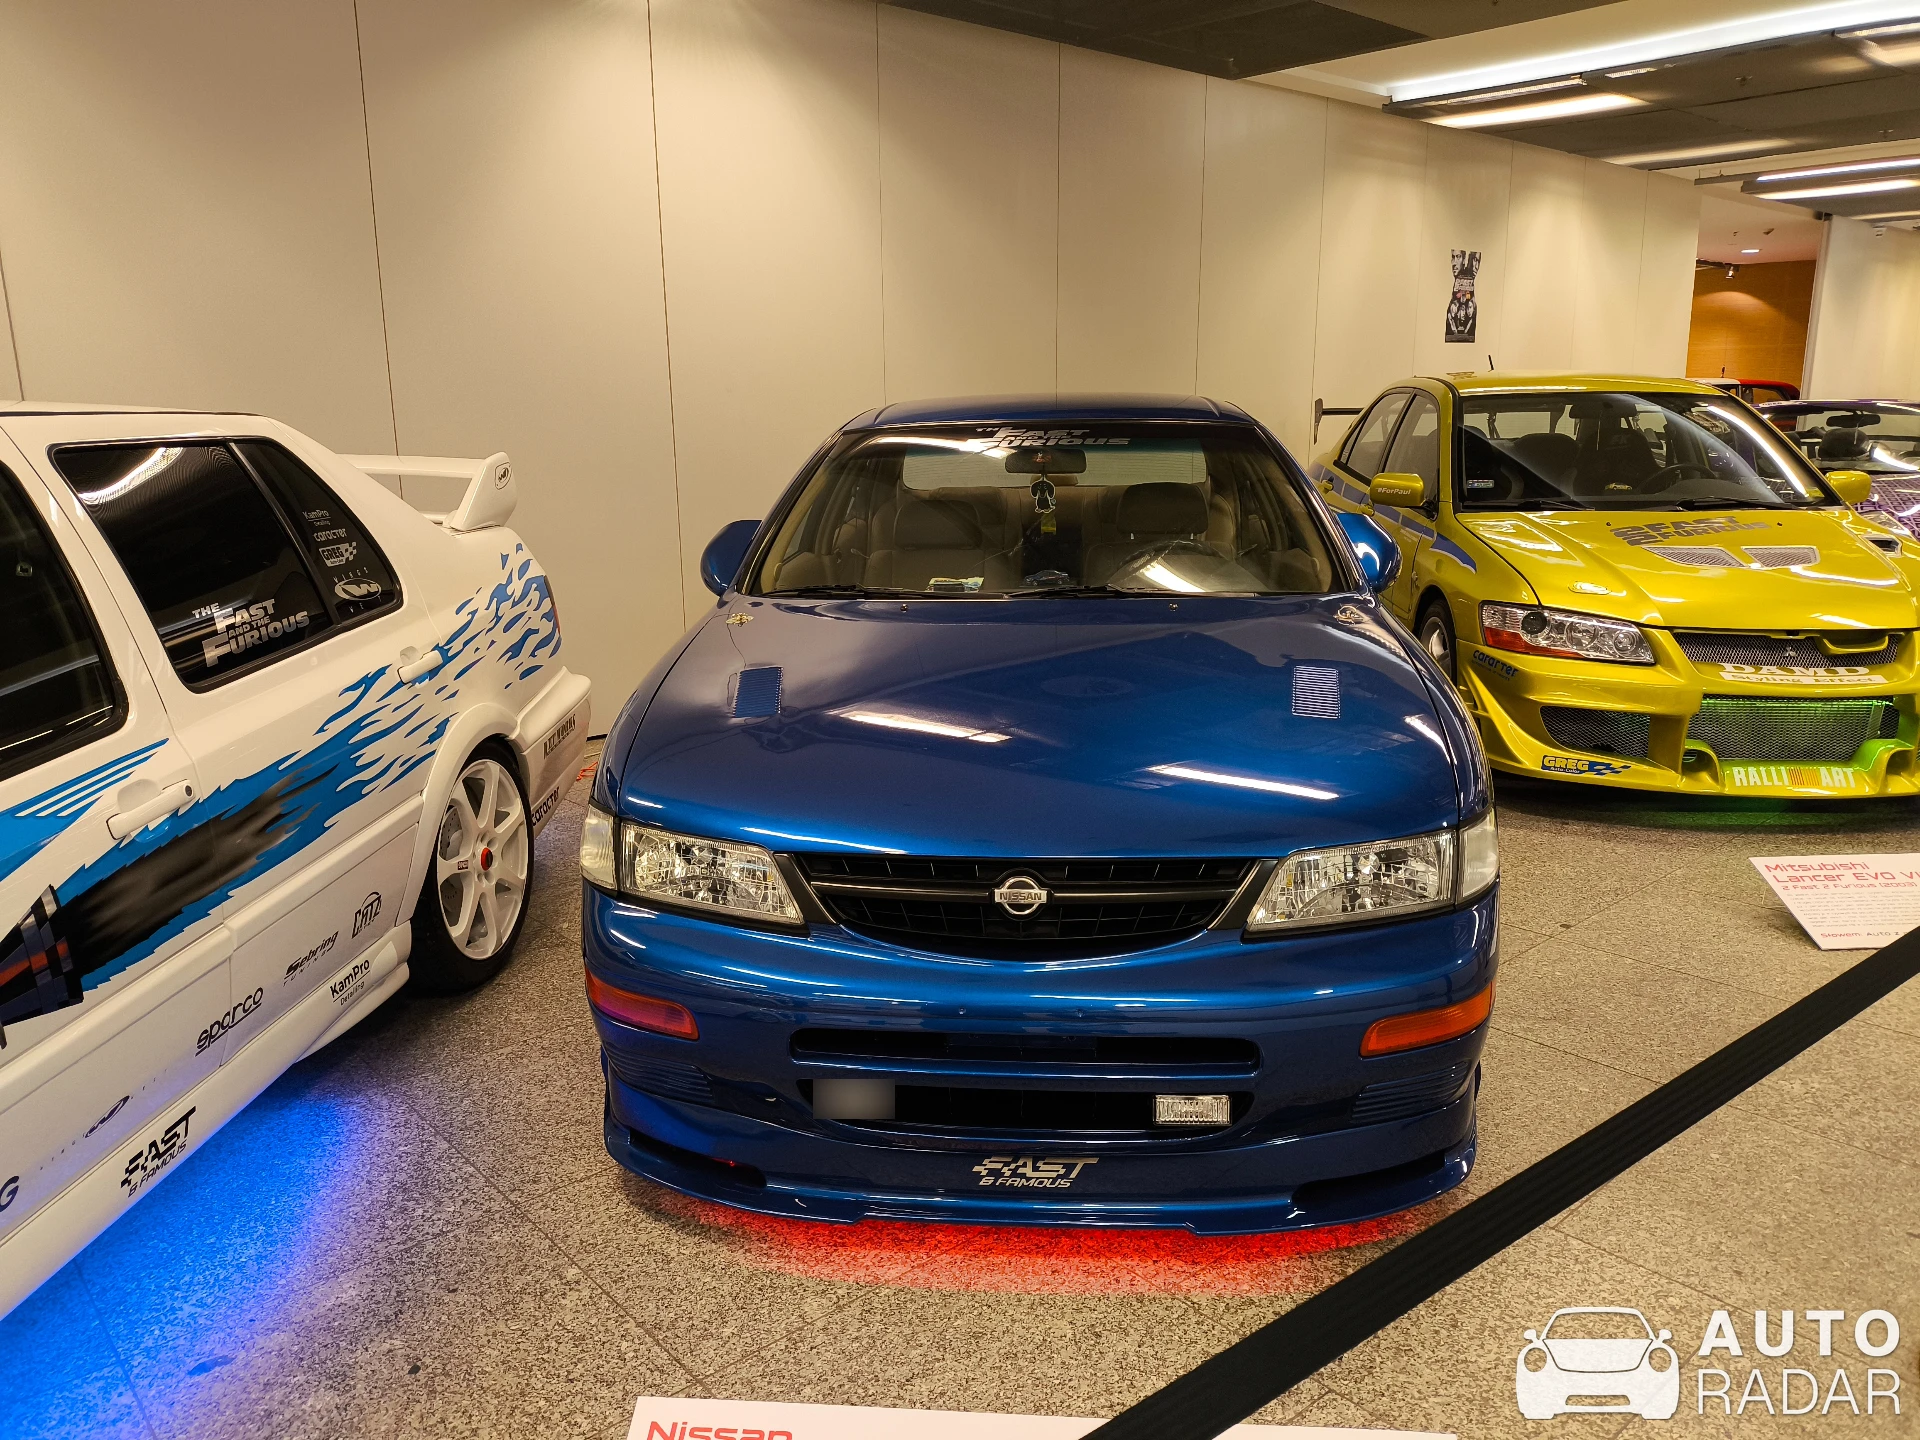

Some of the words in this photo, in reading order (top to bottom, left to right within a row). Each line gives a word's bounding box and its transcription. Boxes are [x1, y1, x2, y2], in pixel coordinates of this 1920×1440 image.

[993, 426, 1090, 438] FAST
[302, 509, 330, 519] KamPro
[321, 546, 346, 560] GREG
[192, 602, 221, 619] THE
[213, 599, 275, 633] FAST
[228, 623, 251, 638] AND
[251, 615, 271, 629] THE
[202, 611, 310, 667] FURIOUS
[1719, 662, 1870, 676] DAMD
[1731, 674, 1804, 684] Styling
[1543, 756, 1590, 771] GREG
[1764, 861, 1870, 873] Mitsubishi
[1772, 873, 1846, 883] Lancer
[1852, 871, 1896, 881] EVO
[1000, 892, 1042, 901] NISSAN
[284, 931, 339, 980] Sebring
[330, 959, 370, 999] KamPro
[195, 987, 264, 1054] sparco
[120, 1105, 197, 1188] FAST
[139, 1149, 188, 1188] FAMOUS
[971, 1156, 1100, 1179] FAST
[995, 1177, 1074, 1188] FAMOUS
